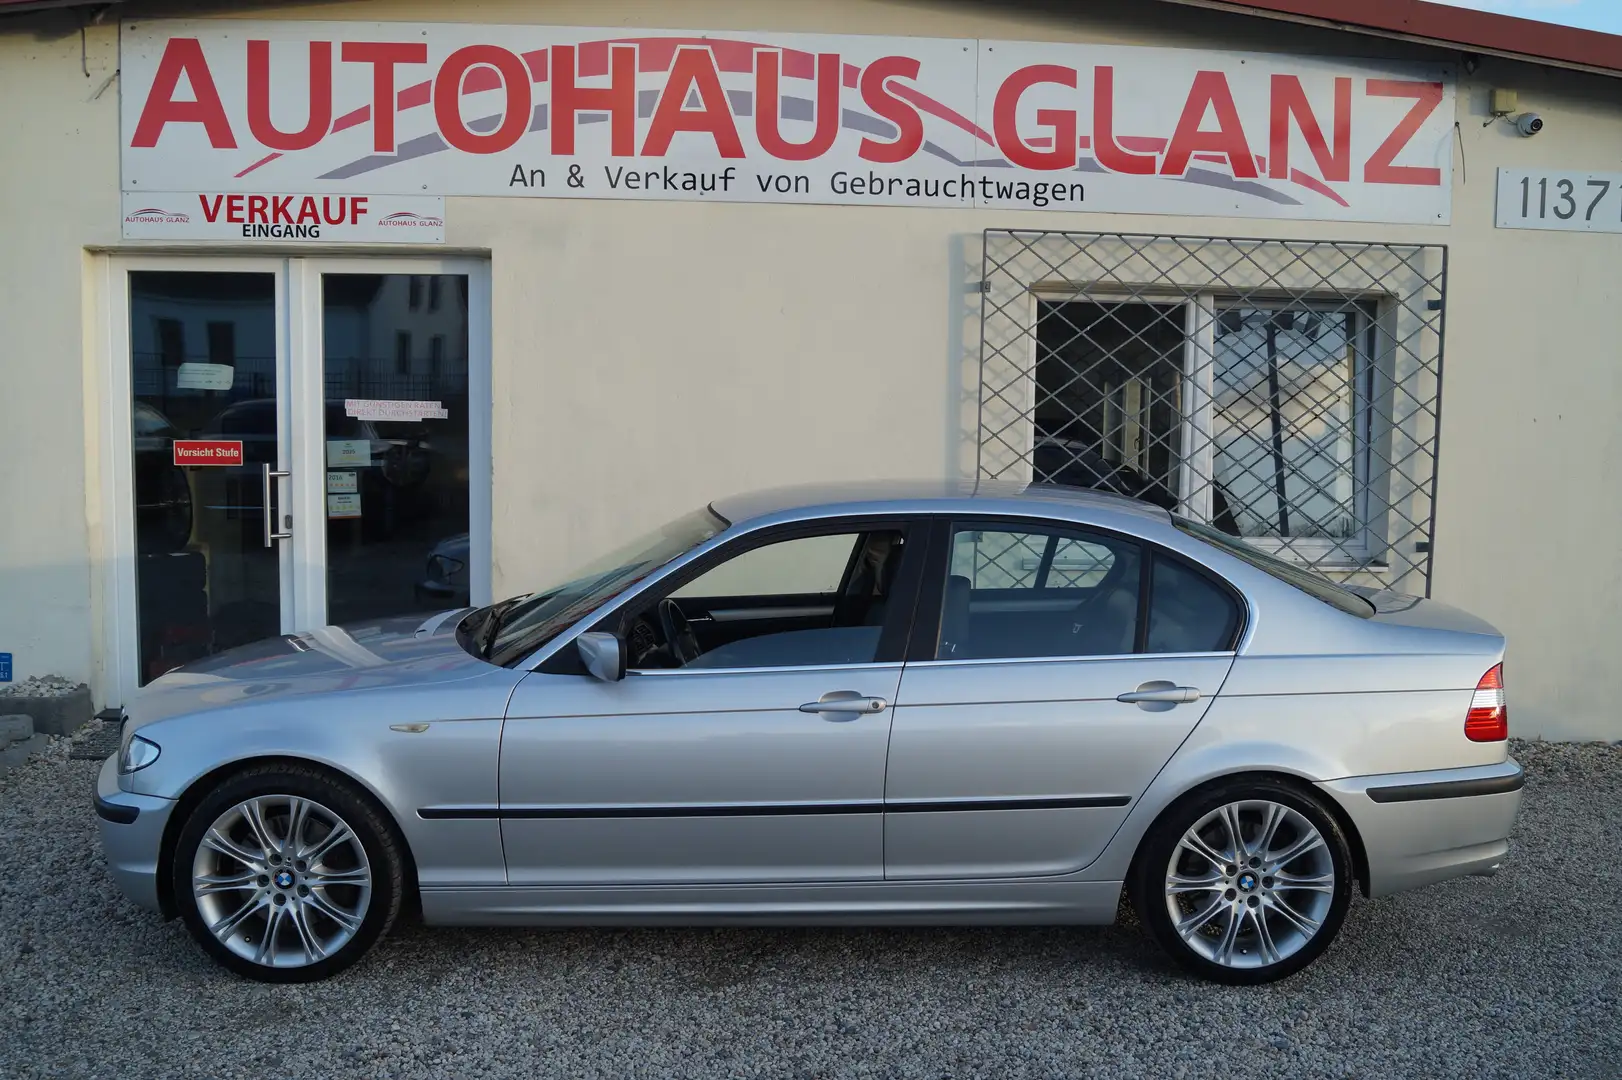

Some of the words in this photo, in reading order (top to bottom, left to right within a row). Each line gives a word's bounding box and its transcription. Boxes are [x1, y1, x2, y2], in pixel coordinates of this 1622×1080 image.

[130, 37, 924, 163] AUTOHAUS
[992, 63, 1444, 186] GLANZ
[509, 163, 546, 188] An
[566, 163, 585, 189] &
[604, 165, 736, 192] Verkauf
[756, 174, 810, 194] von
[830, 171, 1085, 207] Gebrauchtwagen
[198, 193, 369, 226] VERKAUF
[125, 215, 164, 224] AUTOHAUS
[166, 215, 190, 224] GLANZ
[378, 219, 417, 228] AUTOHAUS
[419, 220, 444, 228] GLANZ
[242, 223, 321, 239] EINGANG
[177, 447, 214, 457] Vorsicht
[215, 447, 239, 457] Stufe
